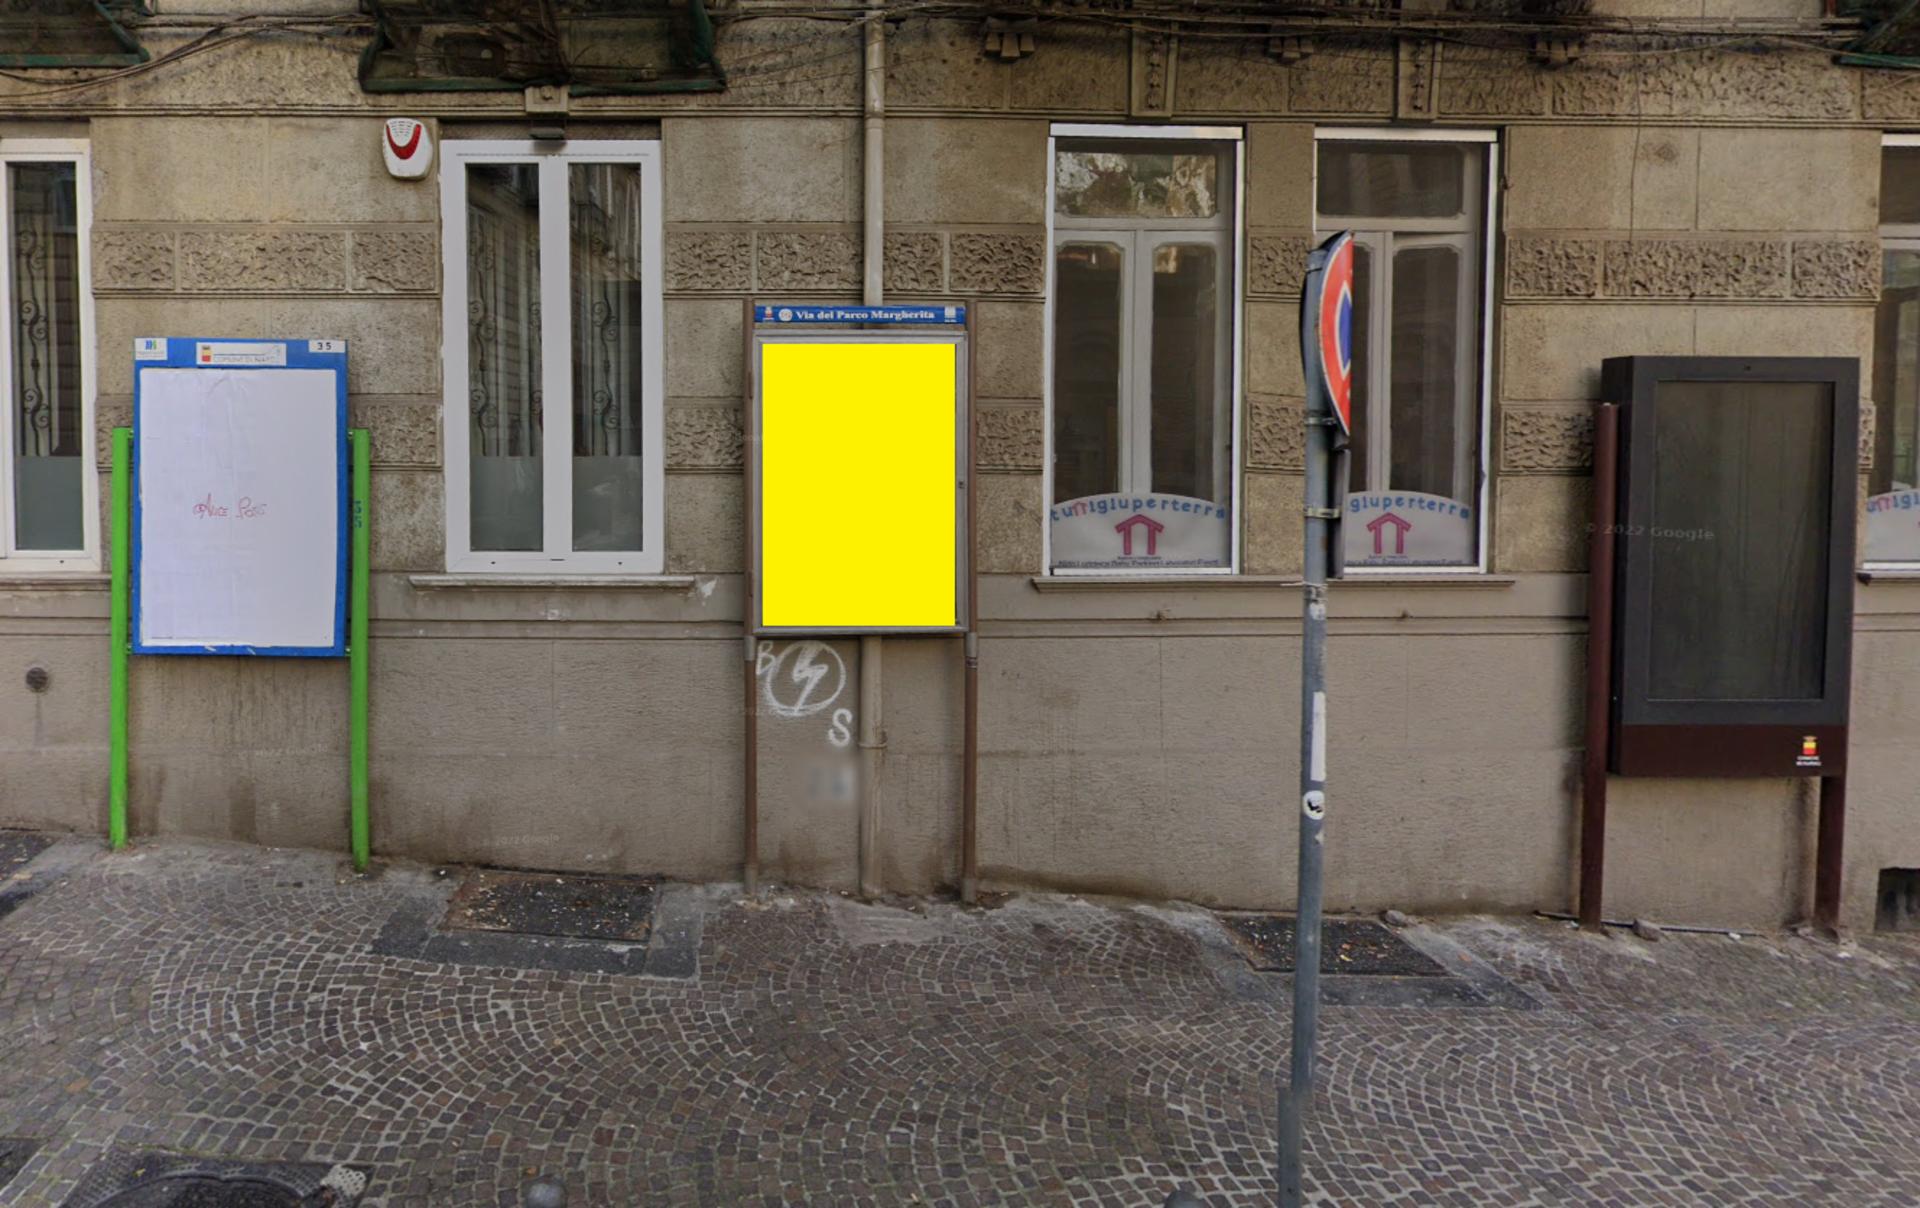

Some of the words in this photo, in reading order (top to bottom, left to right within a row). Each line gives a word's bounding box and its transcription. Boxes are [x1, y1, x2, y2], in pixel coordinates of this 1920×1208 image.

[796, 311, 815, 320] Via
[817, 311, 834, 320] del
[837, 311, 868, 320] Parco
[871, 310, 935, 321] Margherita
[317, 342, 332, 351] 35
